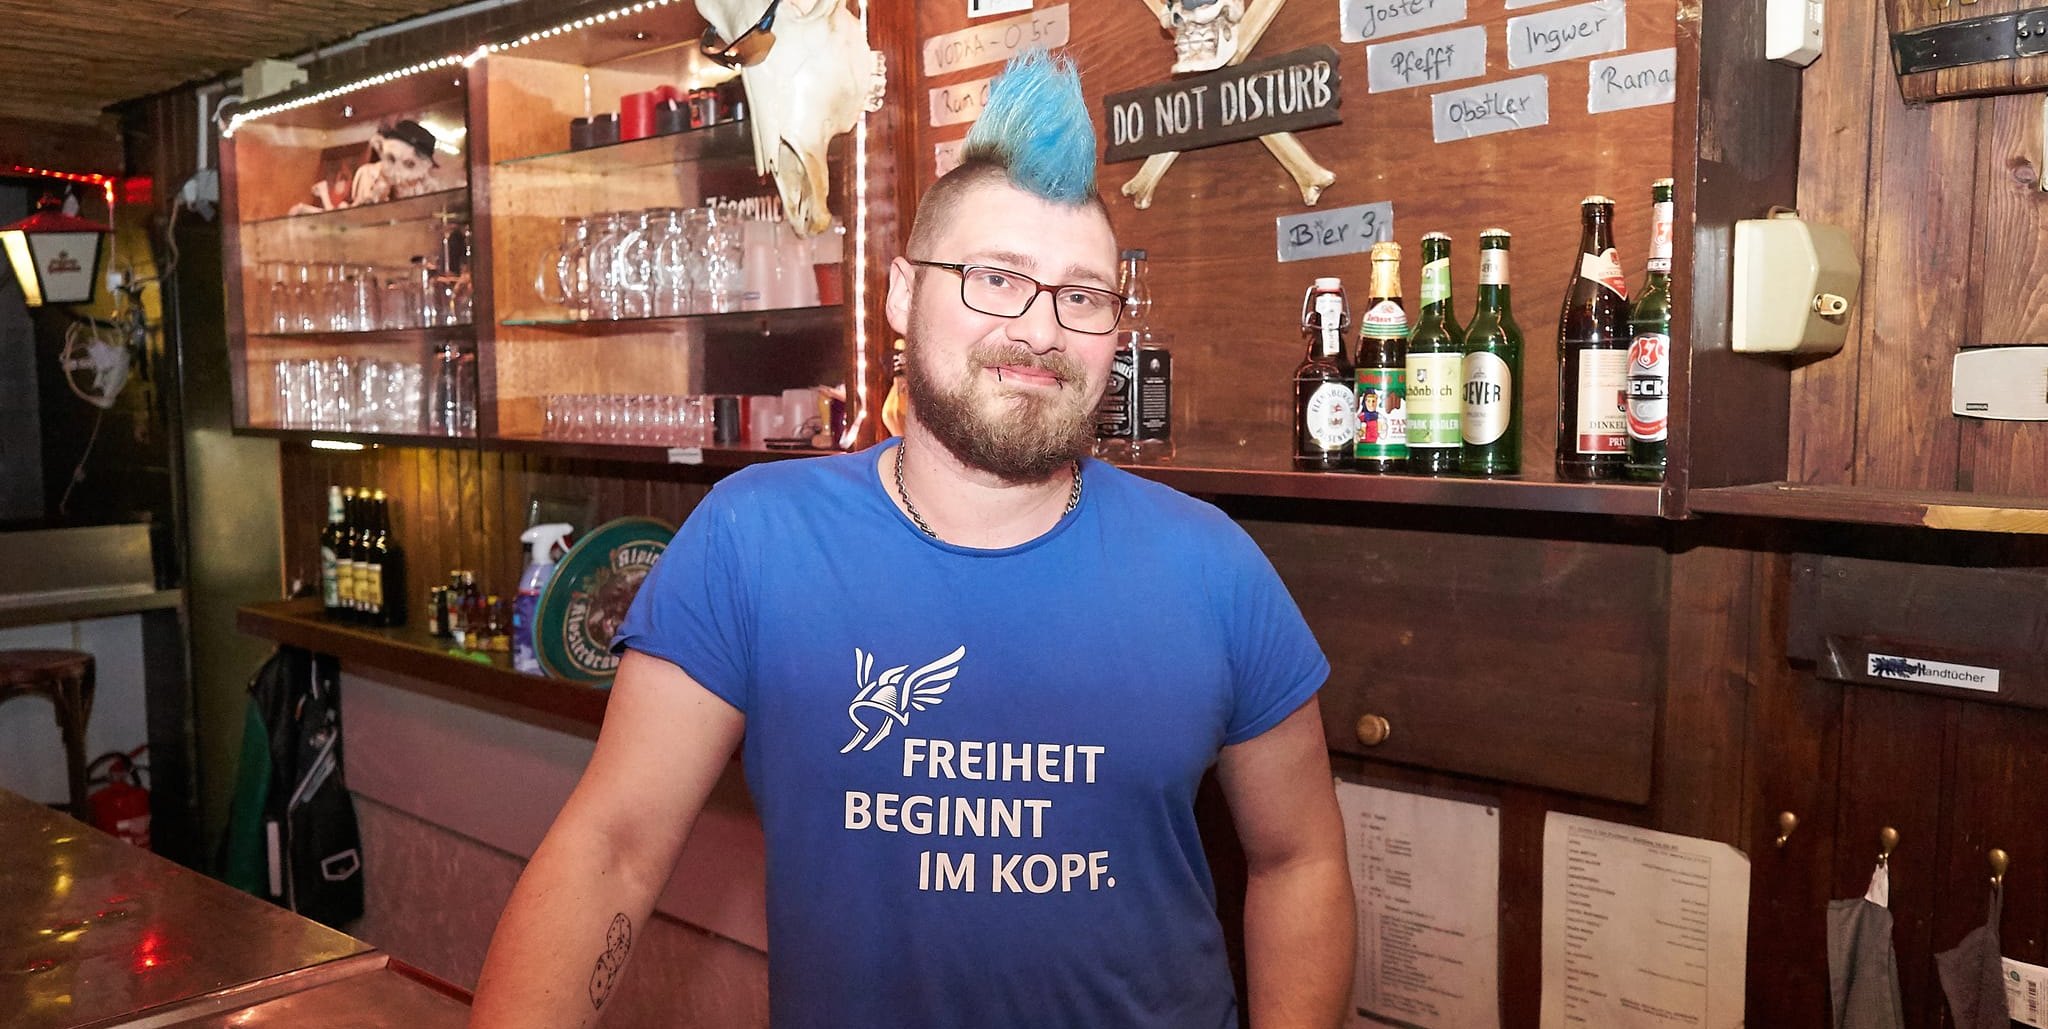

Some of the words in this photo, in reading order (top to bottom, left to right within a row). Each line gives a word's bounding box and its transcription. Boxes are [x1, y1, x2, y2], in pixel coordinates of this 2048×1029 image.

[1526, 17, 1607, 53] Ingwer
[1391, 44, 1455, 83] Pfeffi
[1113, 102, 1144, 146] DO
[1155, 86, 1208, 137] NOT
[1220, 60, 1332, 127] DISTURB
[1449, 93, 1531, 123] Obstler
[1289, 219, 1349, 247] Bier
[1406, 384, 1453, 397] hönbch
[1463, 380, 1501, 405] JEVER
[1917, 662, 1985, 684] Handtücher
[903, 738, 1105, 784] FREIHEIT
[844, 790, 1052, 838] BEGINNT
[918, 850, 975, 892] IM
[991, 850, 1116, 894] KOPF.
